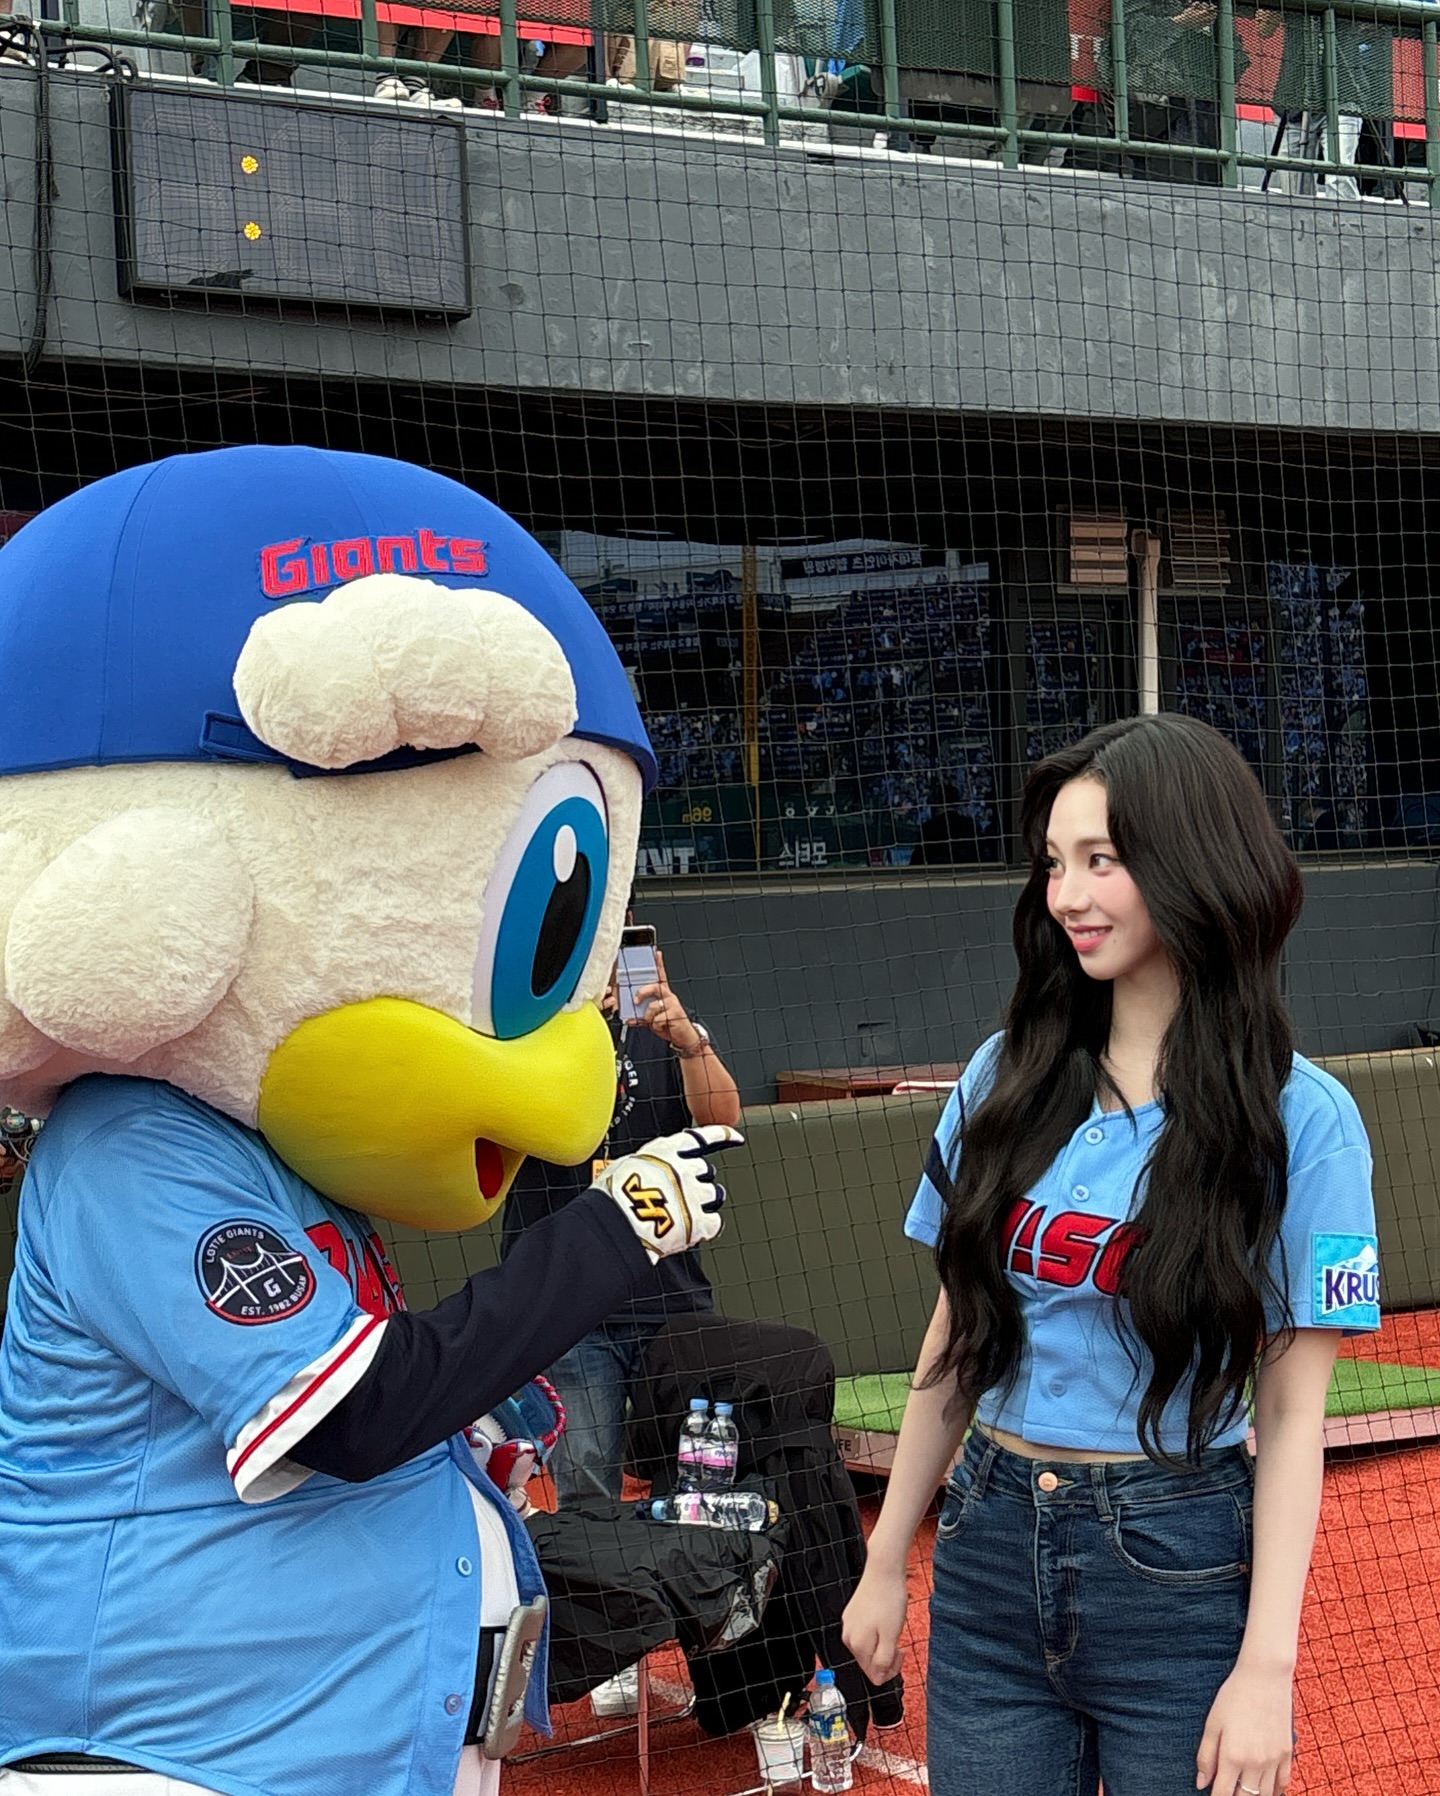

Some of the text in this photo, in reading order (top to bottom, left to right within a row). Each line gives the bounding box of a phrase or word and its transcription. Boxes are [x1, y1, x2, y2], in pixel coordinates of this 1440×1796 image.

[206, 1234, 226, 1264] LOTTE
[226, 1227, 265, 1242] GIANTS
[241, 1305, 265, 1316] EST.
[290, 1274, 307, 1303] BUSAN
[263, 1277, 282, 1298] G
[1325, 1268, 1379, 1312] KRU
